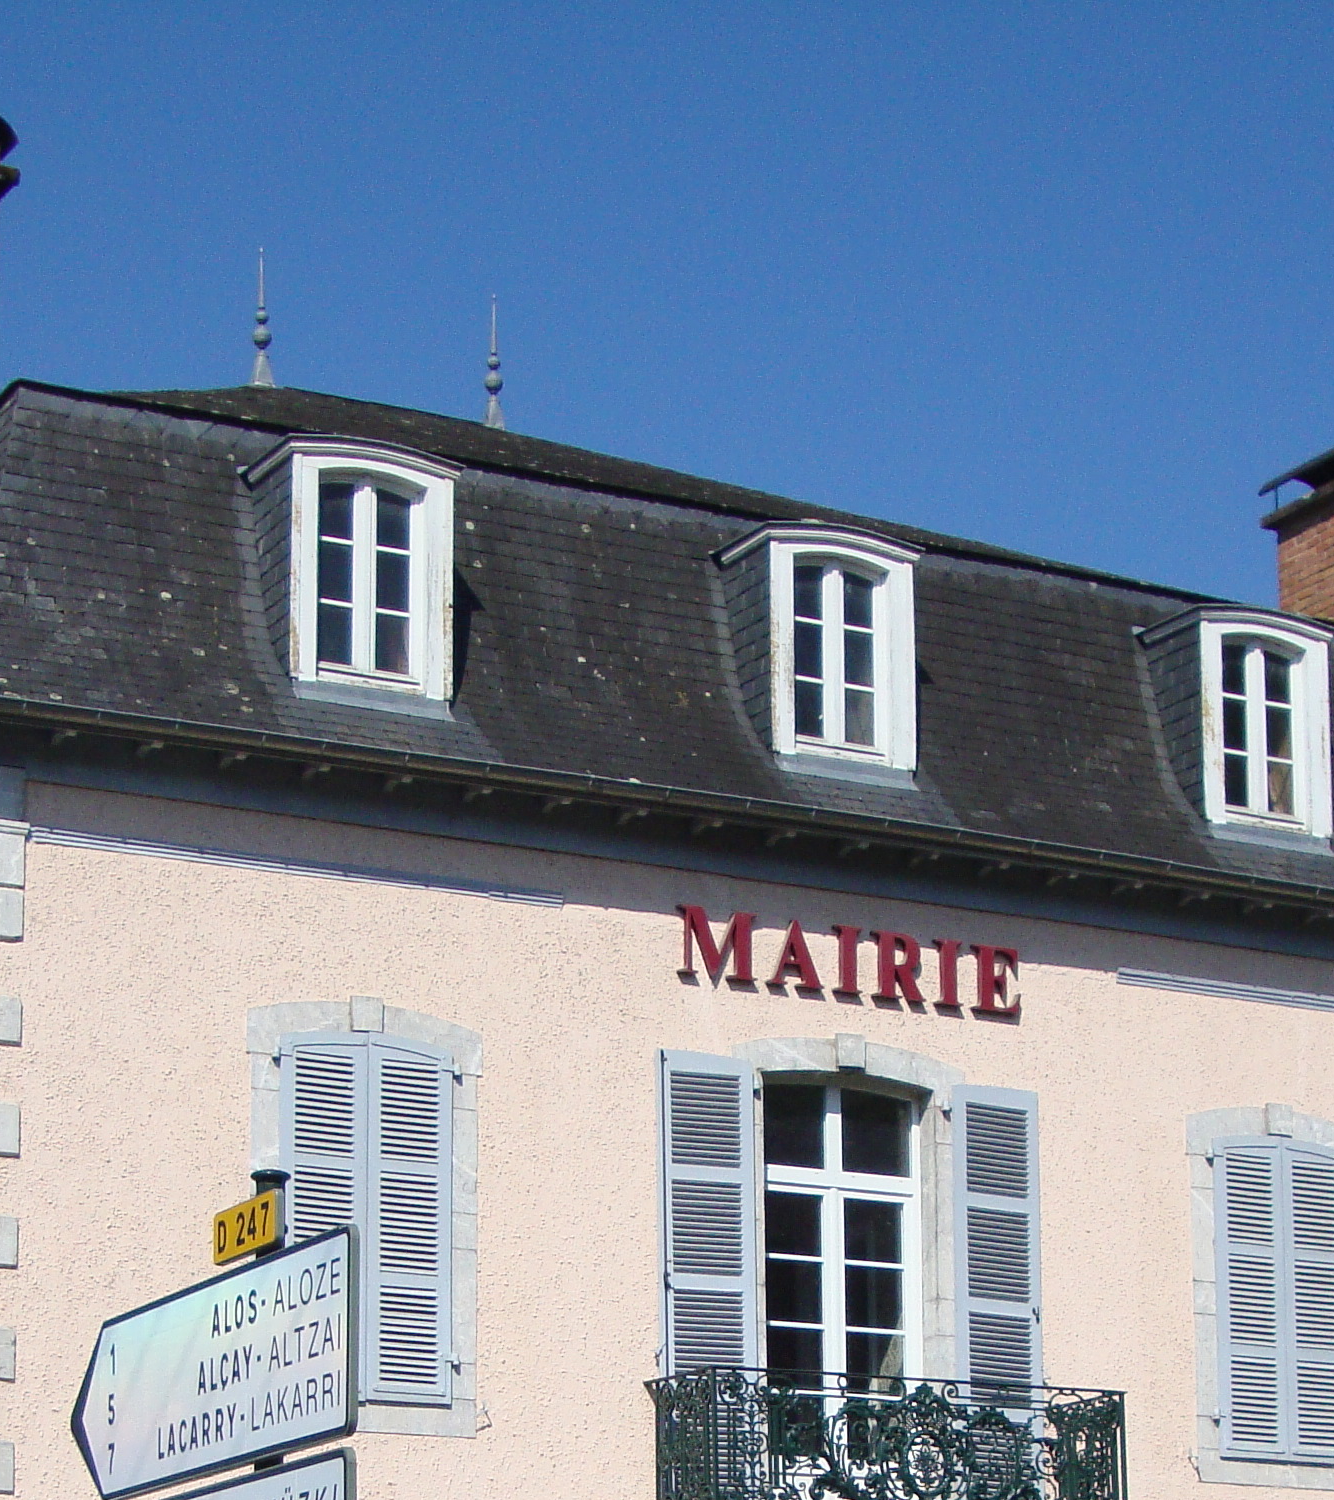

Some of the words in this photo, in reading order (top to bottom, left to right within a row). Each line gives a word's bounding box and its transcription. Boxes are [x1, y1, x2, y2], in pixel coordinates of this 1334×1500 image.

[676, 904, 1021, 1017] MAIRIE
[217, 1219, 227, 1255] D
[236, 1200, 270, 1247] 247
[110, 1343, 117, 1376] 1
[107, 1393, 115, 1425] 5
[107, 1442, 115, 1475] 7
